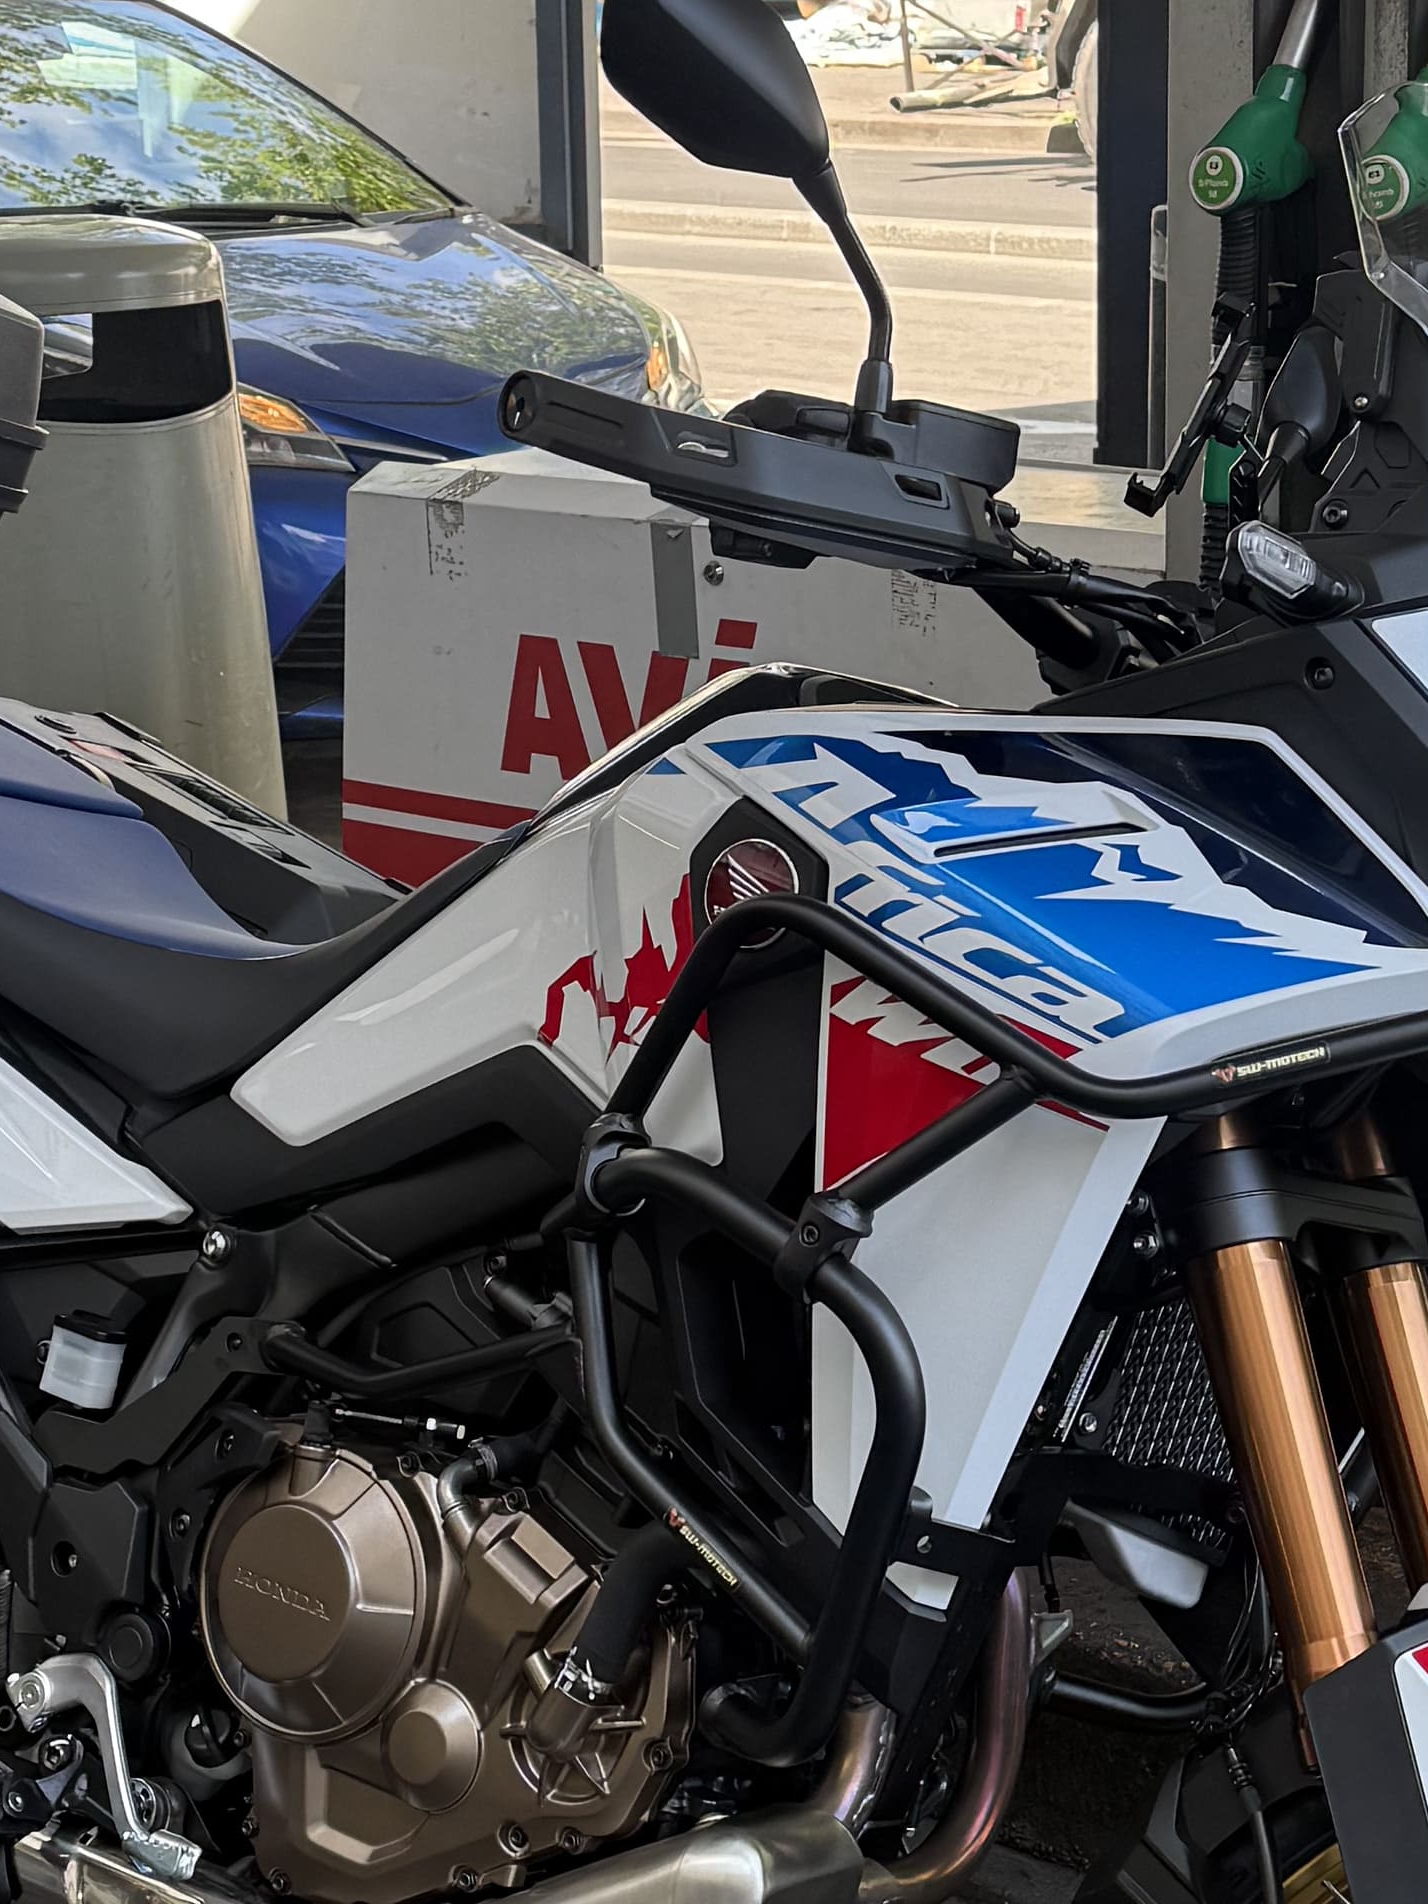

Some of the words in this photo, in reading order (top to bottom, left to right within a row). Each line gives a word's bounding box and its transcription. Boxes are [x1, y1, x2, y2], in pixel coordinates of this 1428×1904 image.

[1236, 1046, 1325, 1077] SW-MOTECH
[679, 1525, 738, 1587] SW-MOTECH
[233, 1566, 331, 1622] HONDA
